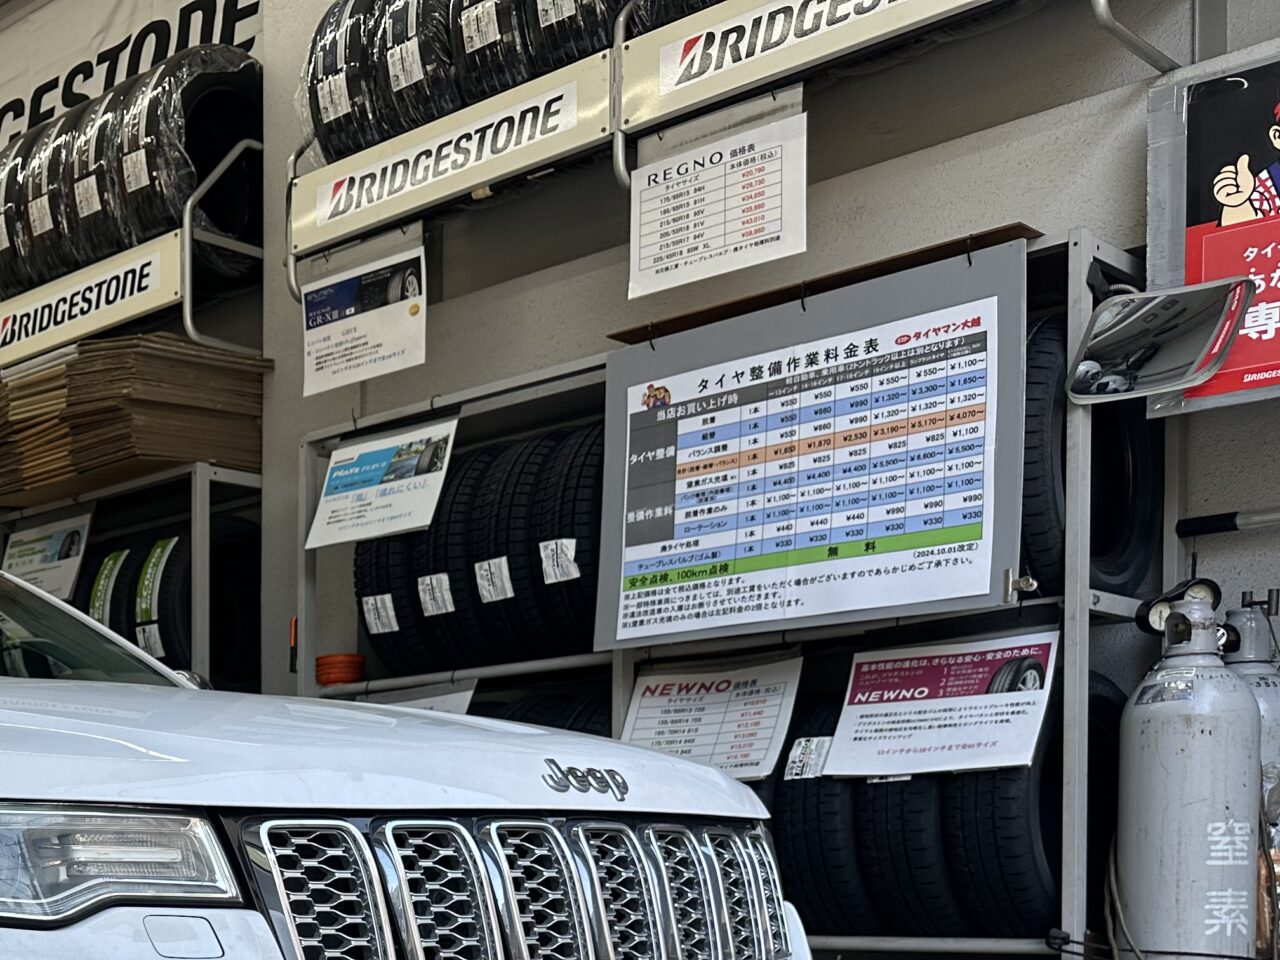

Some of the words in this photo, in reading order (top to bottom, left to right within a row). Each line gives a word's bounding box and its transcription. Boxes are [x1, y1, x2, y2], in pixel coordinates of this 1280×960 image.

[675, 0, 908, 87] BRIDGE
[327, 93, 565, 221] BRIDGESTONE
[647, 151, 724, 187] REGNO
[729, 143, 757, 159] 価格表
[1243, 242, 1280, 262] タイ
[697, 335, 880, 394] タイヤ整備作業料金表
[656, 392, 738, 422] 当店お買い上げ時
[629, 444, 675, 466] タイヤ整備
[641, 679, 732, 696] NEWNO
[854, 687, 929, 702] NEWNO
[541, 758, 629, 802] Jeep
